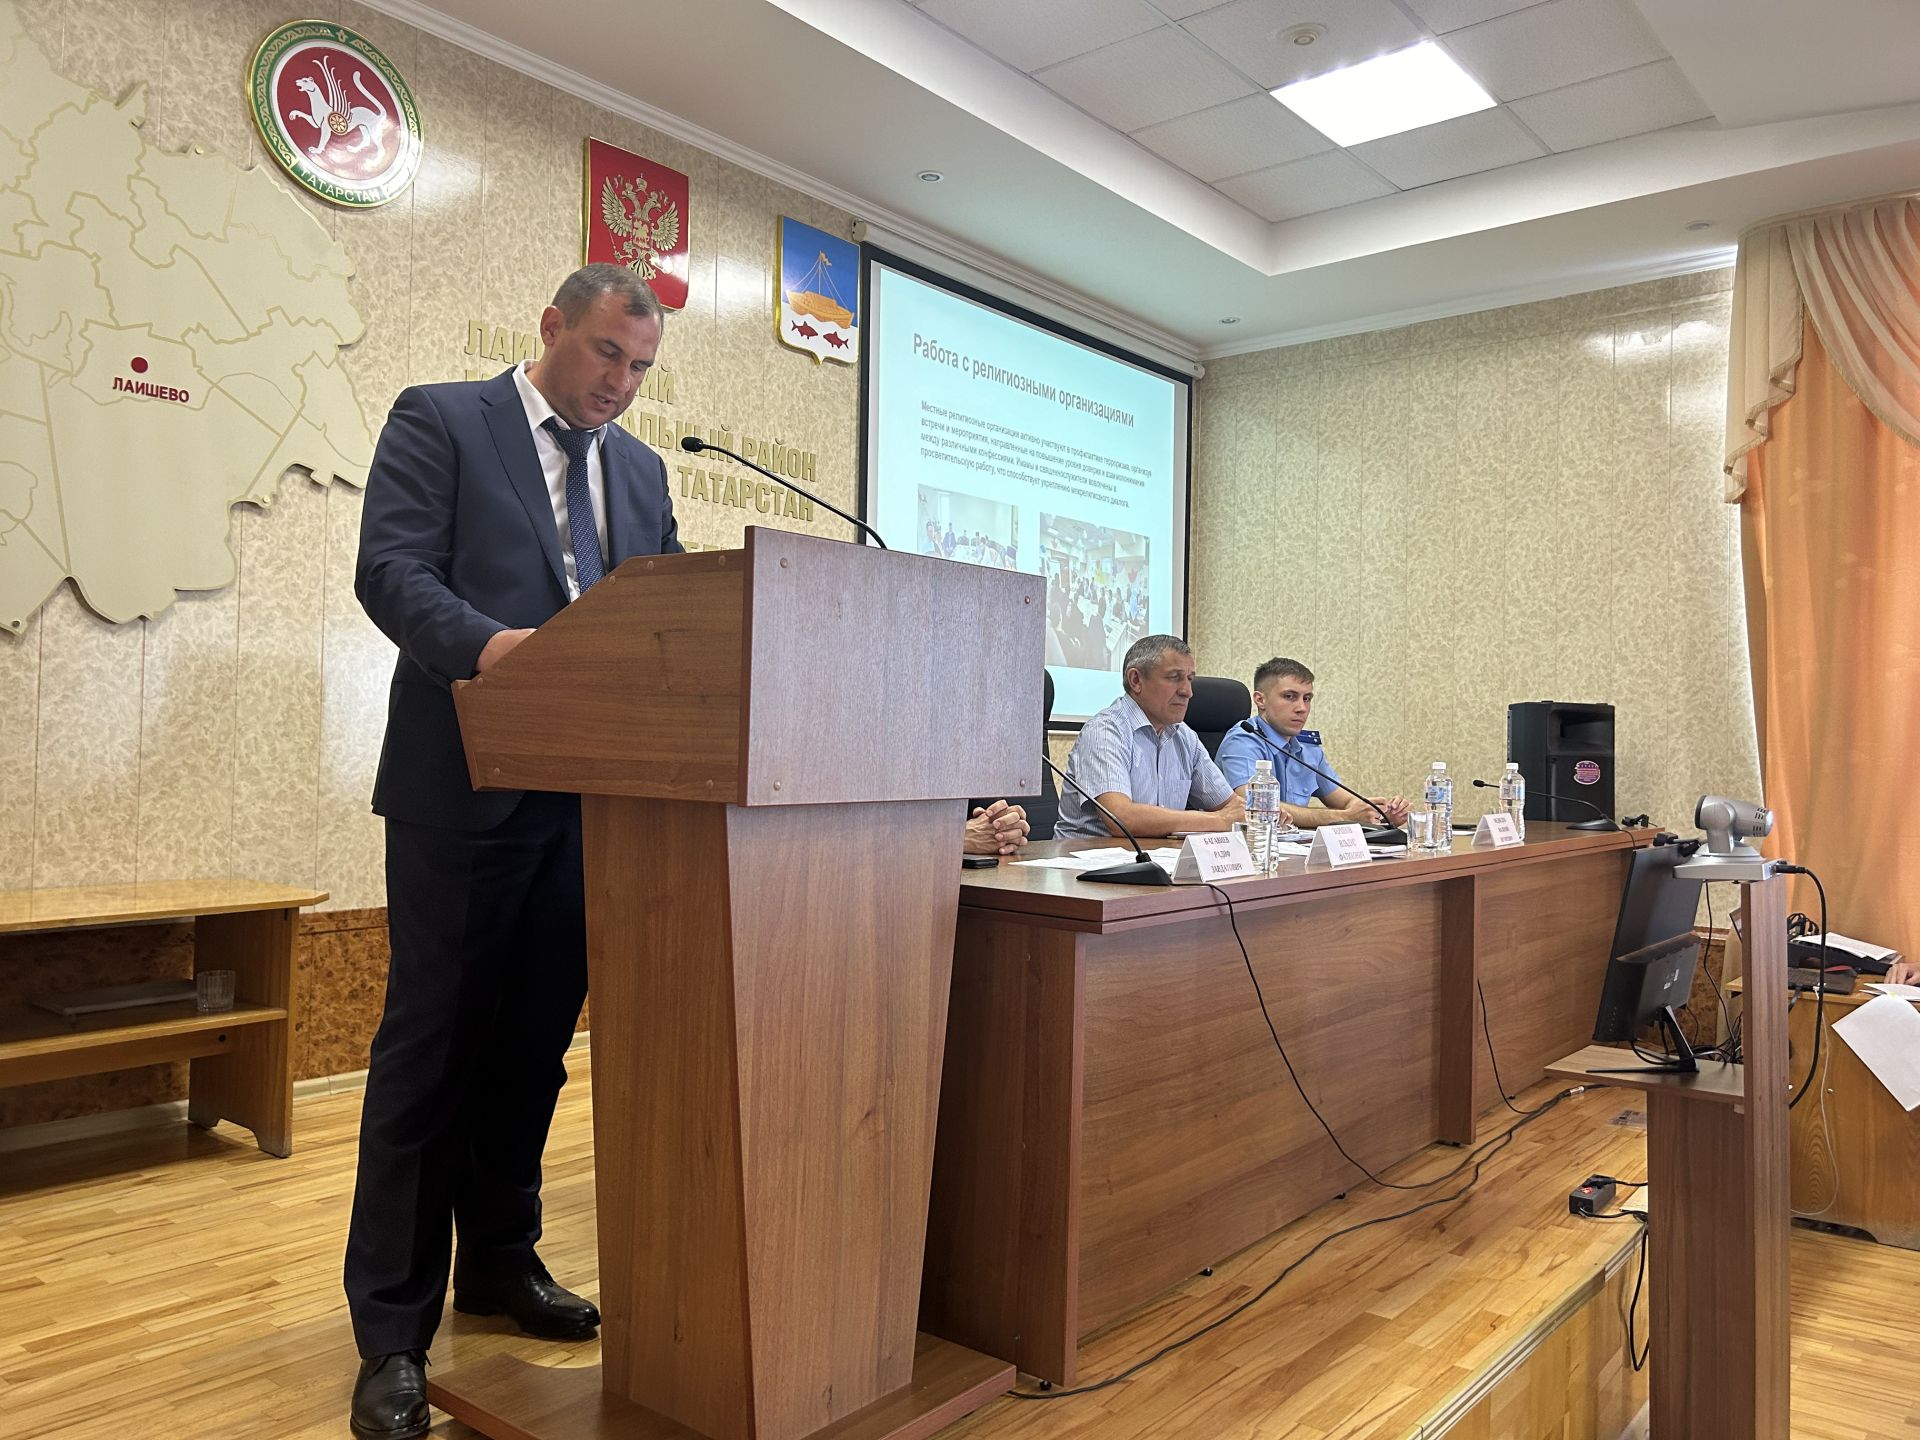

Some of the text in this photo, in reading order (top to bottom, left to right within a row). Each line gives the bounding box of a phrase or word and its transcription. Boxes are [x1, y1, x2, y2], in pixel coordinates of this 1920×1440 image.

[301, 167, 381, 202] ТАТАРСТАН
[112, 376, 190, 403] ЛАИШЕВО
[913, 333, 1134, 428] Работа с религиозными организациями
[921, 400, 948, 417] Местные
[948, 411, 986, 428] религиозные
[921, 418, 945, 431] встречи
[920, 433, 940, 447] между
[941, 438, 977, 455] различными
[742, 436, 816, 482] РАЙОН
[920, 448, 975, 469] просветительскую
[678, 466, 813, 521] ТАТАРСТАН
